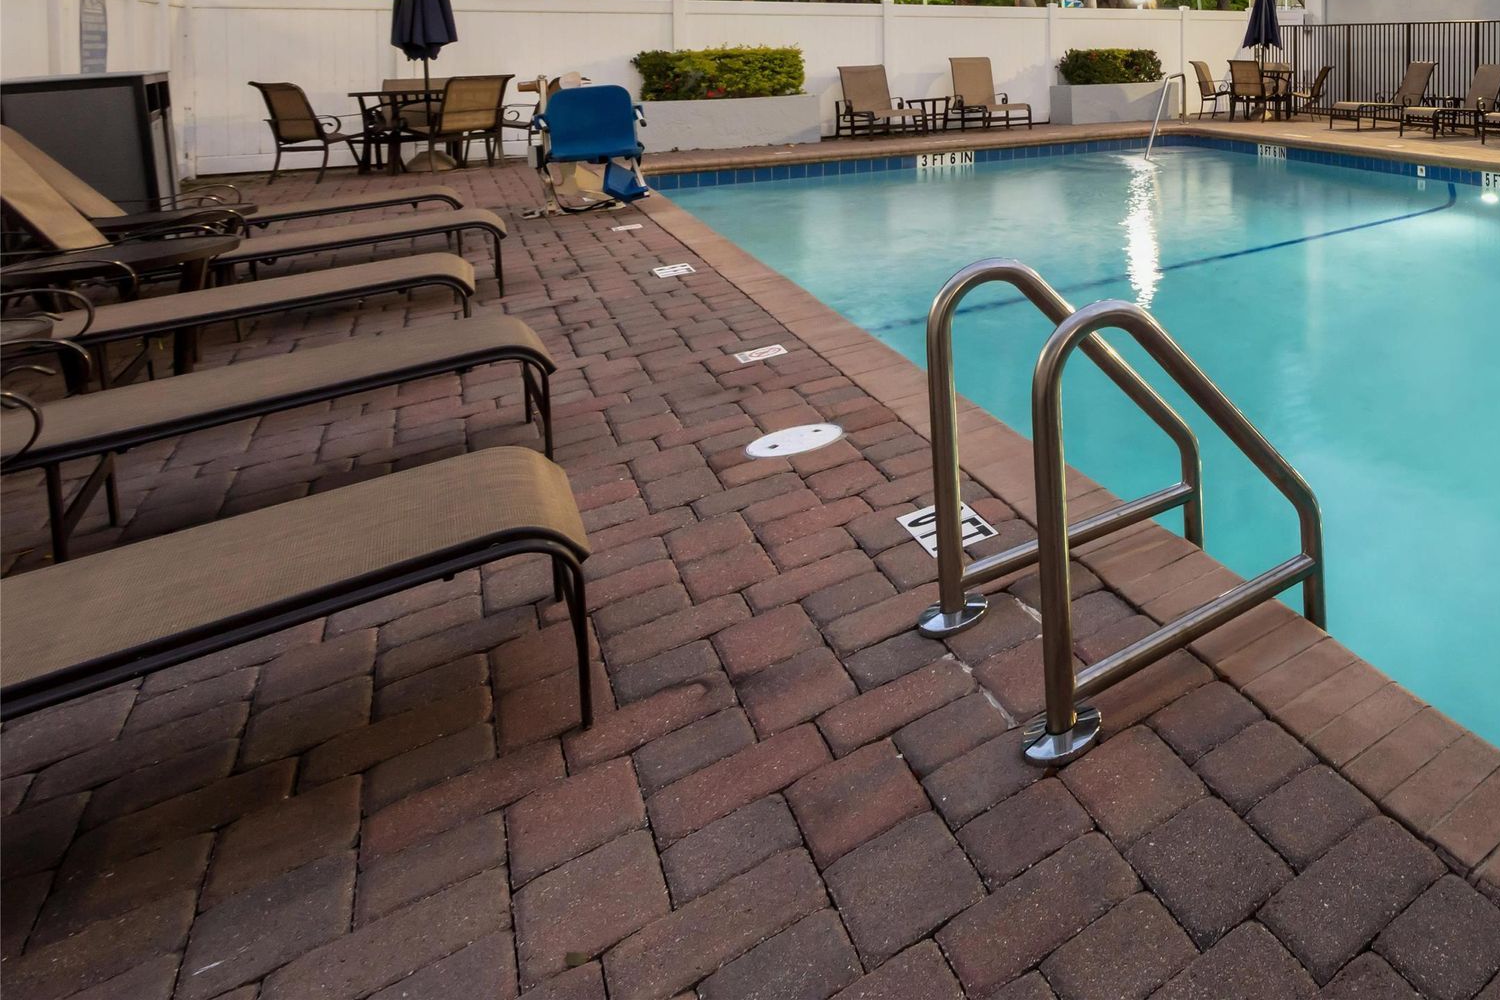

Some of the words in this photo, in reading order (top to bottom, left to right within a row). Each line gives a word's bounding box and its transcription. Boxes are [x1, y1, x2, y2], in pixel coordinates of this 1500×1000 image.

[921, 154, 928, 167] 3
[932, 153, 945, 166] FT
[950, 152, 956, 165] 6
[961, 151, 973, 164] IN
[1265, 146, 1271, 156] FT
[1279, 147, 1286, 159] IN
[1485, 173, 1490, 187] 5
